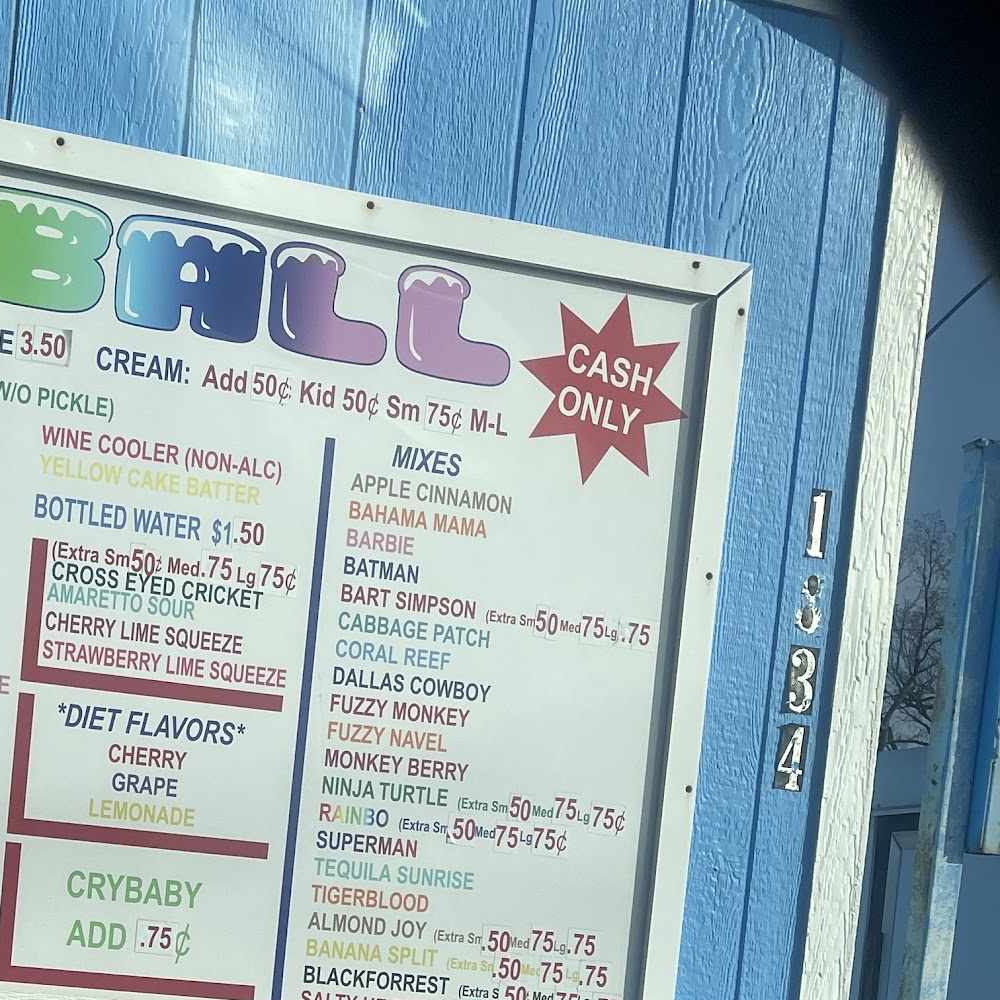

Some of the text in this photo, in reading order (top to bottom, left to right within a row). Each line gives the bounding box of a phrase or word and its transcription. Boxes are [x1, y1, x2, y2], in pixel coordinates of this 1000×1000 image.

[19, 330, 66, 359] 3.50
[567, 343, 654, 396] CASH
[37, 386, 114, 423] PICKLE)
[95, 345, 190, 385] CREAM:
[201, 363, 248, 394] Add
[298, 379, 336, 409] Kid
[385, 394, 420, 422] Sm
[469, 407, 508, 437] M-L
[557, 386, 641, 435] ONLY
[41, 424, 282, 486] WINE COOLER (NON-ALC)
[391, 444, 462, 477] MIXES
[350, 472, 513, 515] APPLE CINNAMON
[33, 493, 127, 530] BOTTLED
[133, 507, 201, 541] WATER
[51, 540, 99, 563] (Extra
[51, 560, 264, 610] CROSS EYED CRICKET
[342, 555, 419, 584] BATMAN
[340, 582, 391, 608] BART
[394, 590, 476, 620] SIMPSON
[44, 610, 243, 655] CHERRY LIME SQUEEZE
[42, 639, 287, 689] STRAWBERRY LIME SQUEEZE
[334, 638, 451, 671] CORAL REEF
[332, 665, 491, 703] DALLAS COWBOY
[329, 693, 471, 728] FUZZY MONKEY
[108, 743, 188, 770] CHERRY
[324, 748, 469, 782] MONKEY BERRY
[111, 772, 179, 798] GRAPE
[321, 775, 488, 812] NINJA TURTLE (Extra
[88, 797, 196, 828] LEMONADE
[318, 802, 389, 828] RAINBO
[315, 829, 418, 858] SUPERMAN
[66, 869, 203, 909] CRYBABY
[311, 883, 429, 913] TIGERBLOOD
[65, 919, 127, 950] ADD
[307, 911, 386, 936] ALMOND
[390, 919, 427, 940] JOY
[303, 964, 450, 995] BLACKFORREST
